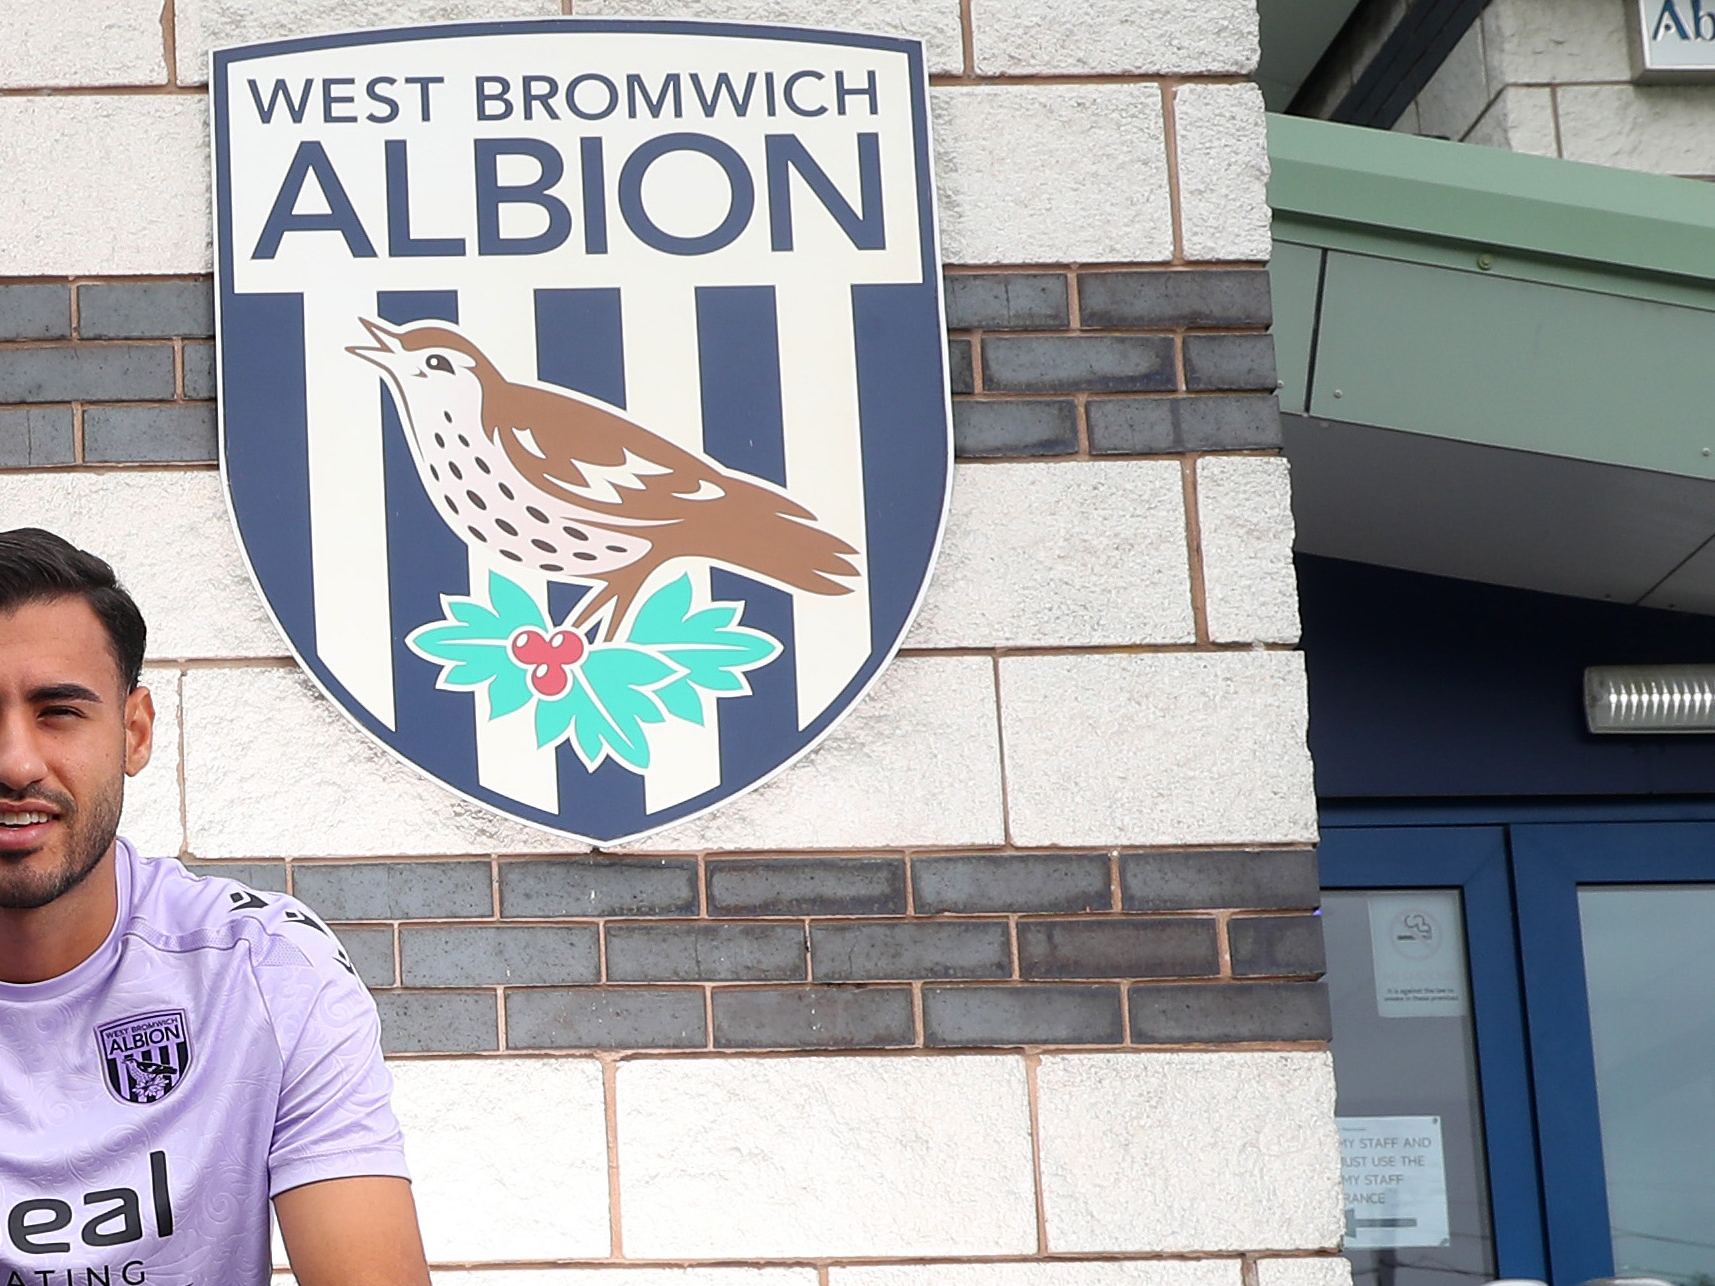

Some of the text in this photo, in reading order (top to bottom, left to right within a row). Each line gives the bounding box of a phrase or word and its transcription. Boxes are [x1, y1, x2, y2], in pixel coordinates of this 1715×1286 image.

[246, 69, 879, 124] WEST BROMWICH
[251, 132, 888, 260] ALBION
[105, 1017, 178, 1039] WEST BROMWICH
[109, 1024, 180, 1055] ALBION
[1360, 1138, 1398, 1149] STAFF
[1403, 1137, 1431, 1148] AND
[1372, 1156, 1395, 1167] USE
[1400, 1155, 1425, 1166] THE
[1364, 1174, 1403, 1185] STAFF
